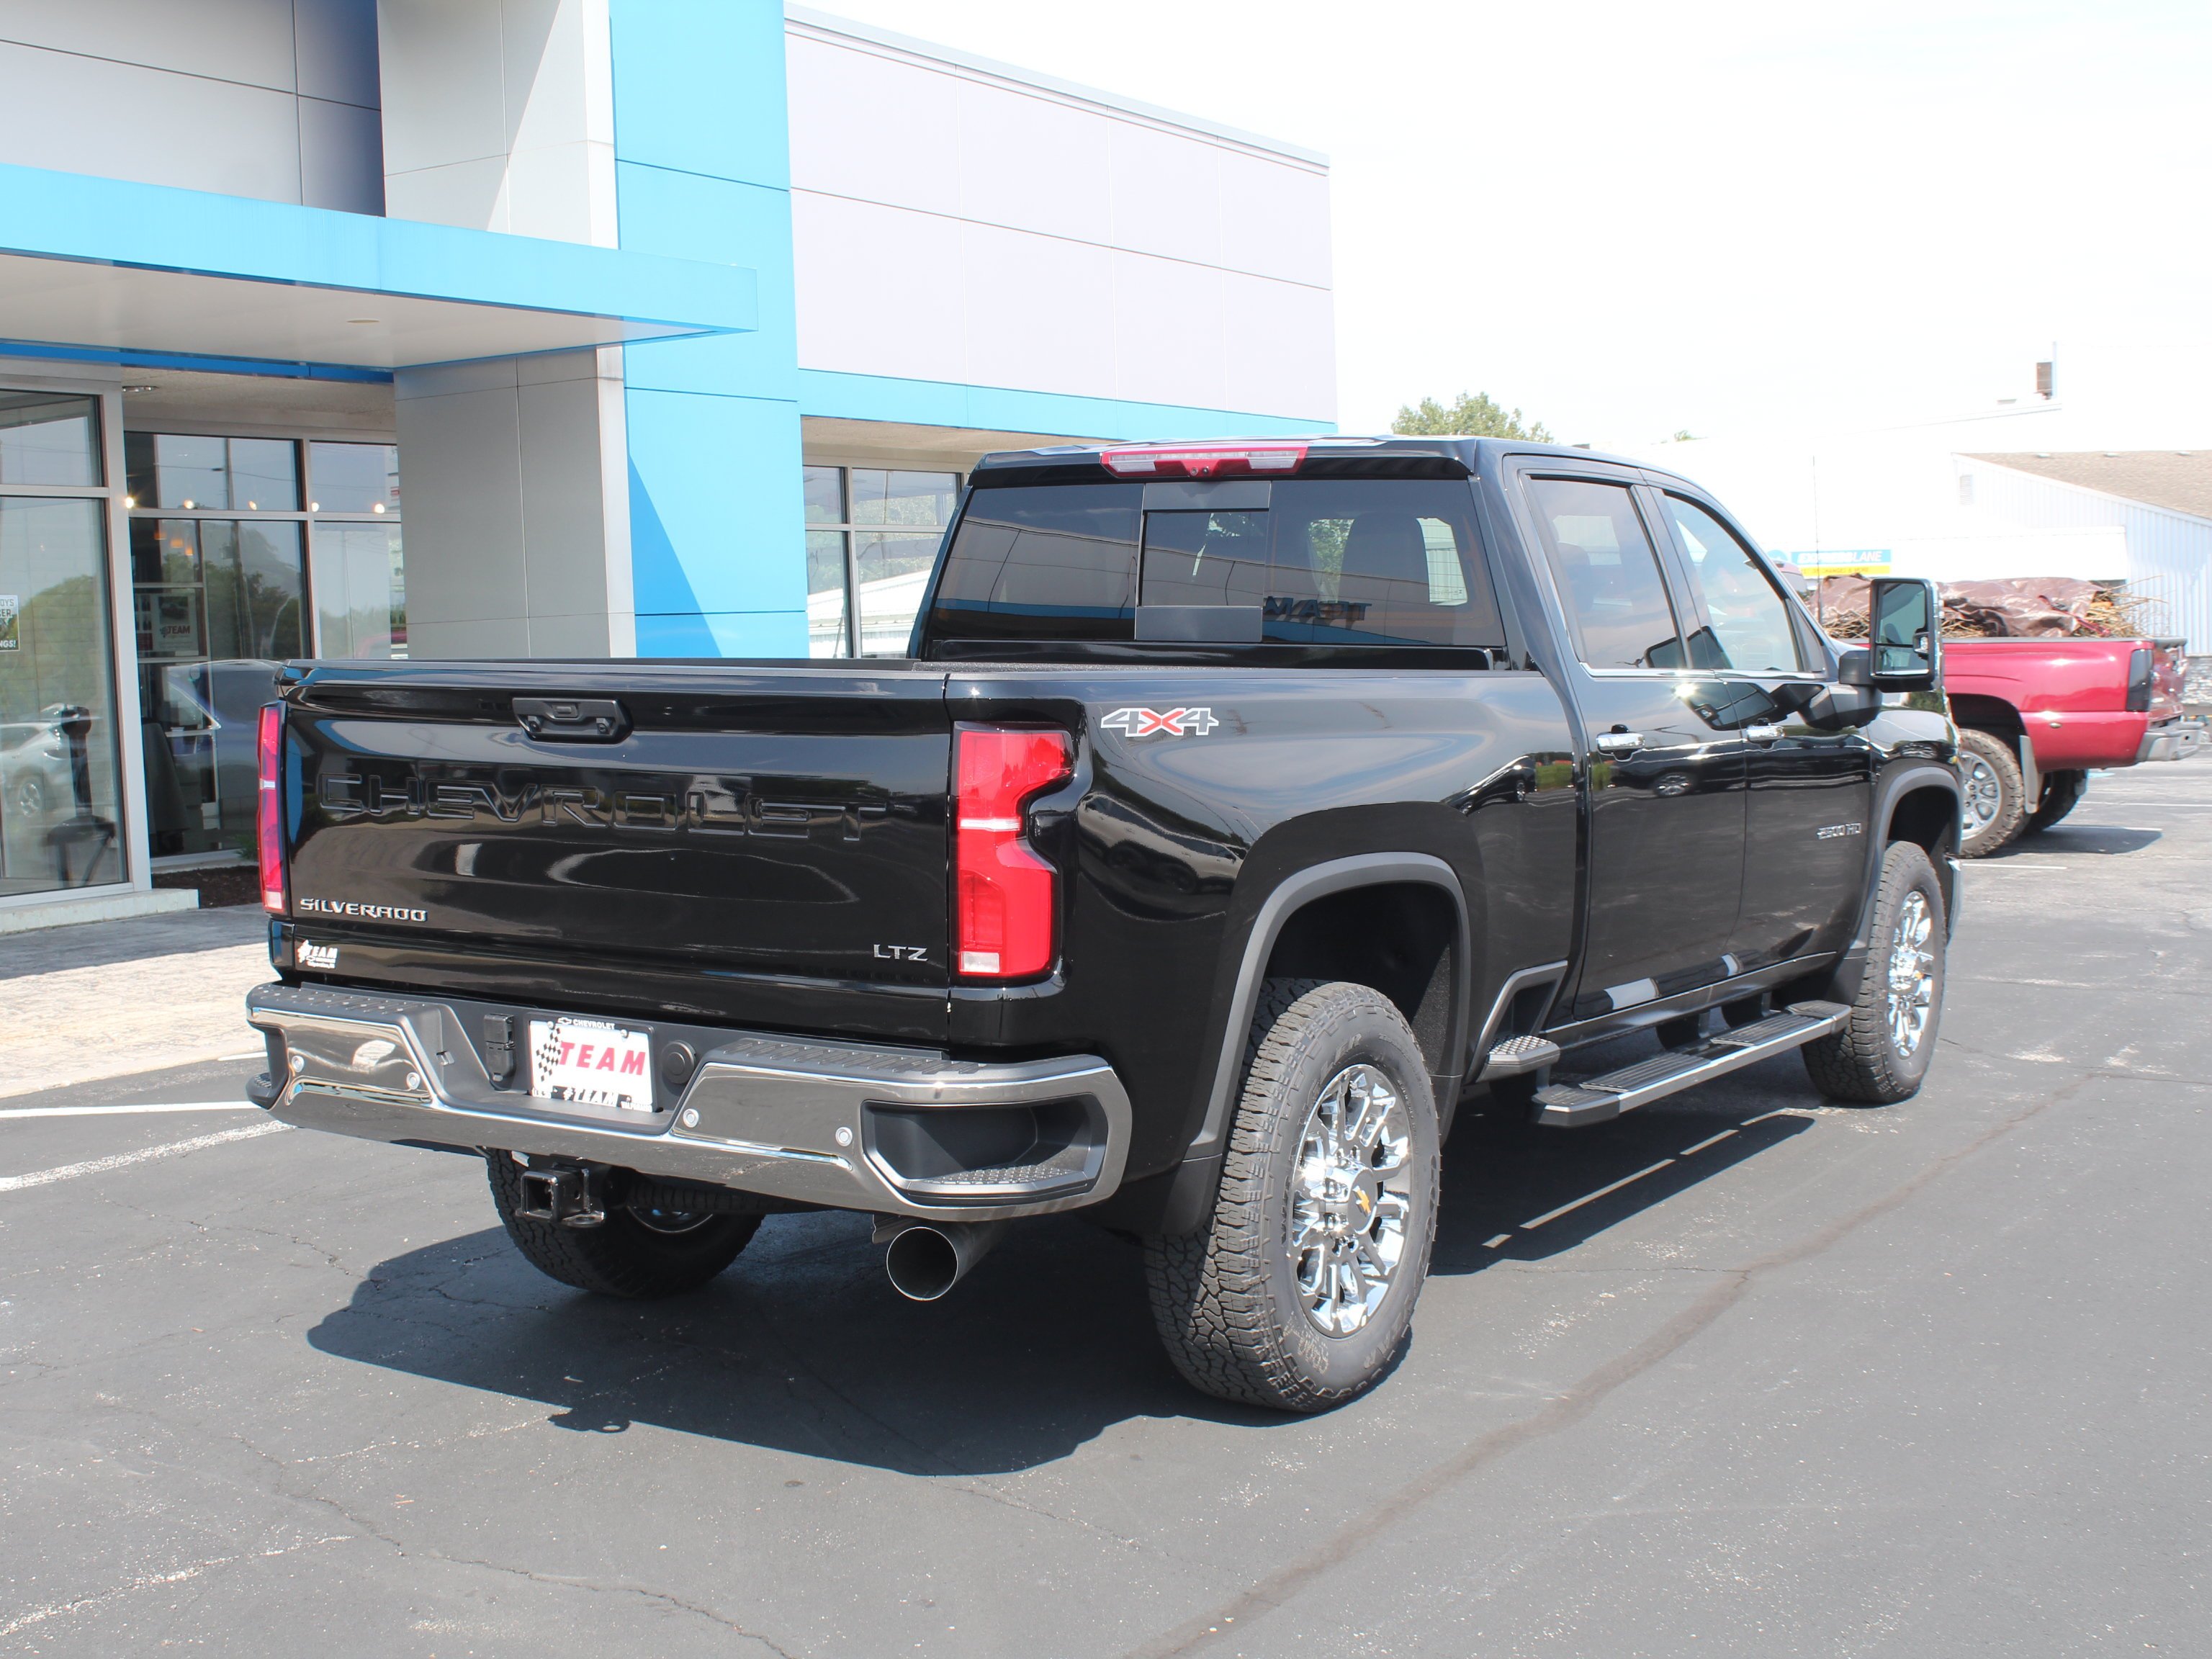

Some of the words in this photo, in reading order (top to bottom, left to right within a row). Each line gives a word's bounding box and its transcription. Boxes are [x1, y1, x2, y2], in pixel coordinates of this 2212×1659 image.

[166, 625, 191, 634] TEAM
[318, 773, 887, 841] CHEVROLET
[300, 898, 428, 922] SILVERADO
[873, 944, 927, 961] LTZ
[572, 1019, 616, 1030] CHEVROLET
[558, 1041, 647, 1076] TEAM
[573, 1087, 619, 1107] TEAM
[1363, 1154, 1437, 1369] GOODYEAR
